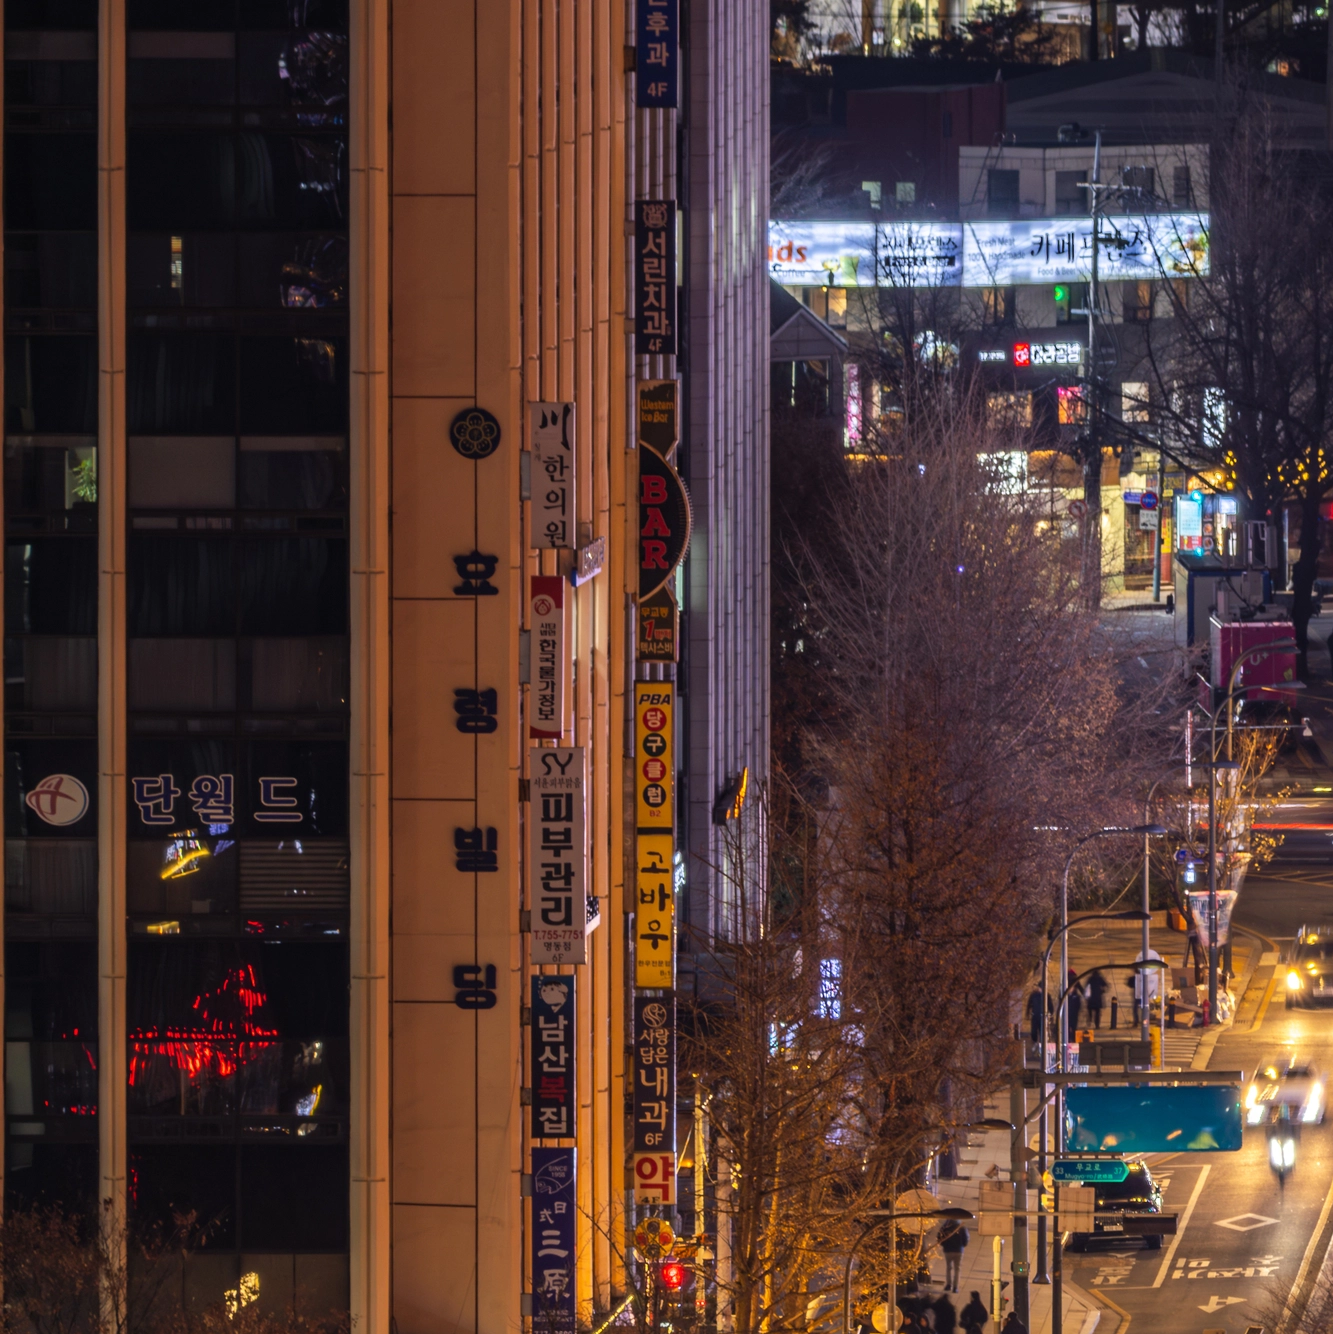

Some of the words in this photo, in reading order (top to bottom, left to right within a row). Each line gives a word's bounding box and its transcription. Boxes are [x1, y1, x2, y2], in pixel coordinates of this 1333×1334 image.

[644, 0, 671, 67] 후과
[647, 82, 668, 97] 4F
[642, 231, 670, 337] 서린치과
[648, 338, 663, 352] 4F
[542, 454, 571, 549] 한의원
[640, 475, 671, 570] BAR
[638, 693, 671, 705] PBA
[643, 709, 664, 805] 당구클럽
[132, 773, 303, 825] 단월드
[540, 792, 575, 927] 피부관리
[639, 851, 671, 951] 고바우
[533, 929, 584, 941] T.755-7751
[551, 953, 564, 963] 6F
[639, 1028, 669, 1046] 사랑
[537, 1014, 569, 1134] 남산복집
[638, 1067, 669, 1132] 내과
[644, 1133, 664, 1146] 6F
[635, 1155, 675, 1202] 약
[1054, 1166, 1065, 1176] 33
[1075, 1163, 1101, 1172] 무교로
[1113, 1166, 1124, 1176] 37
